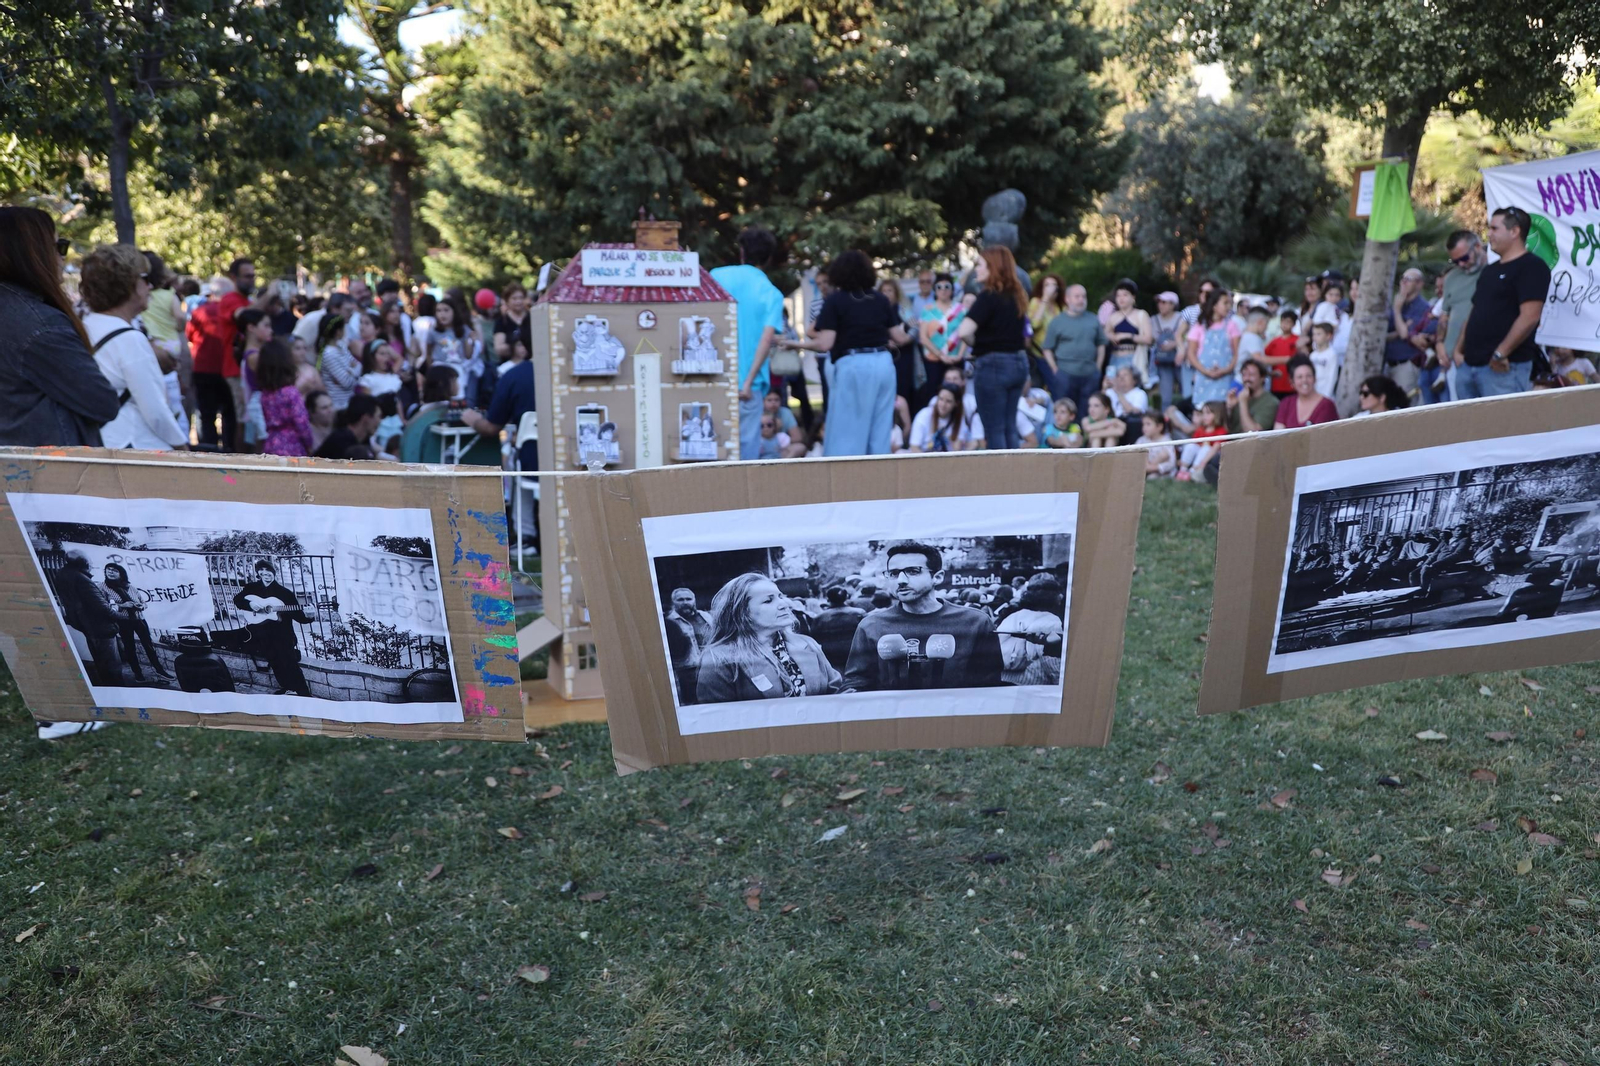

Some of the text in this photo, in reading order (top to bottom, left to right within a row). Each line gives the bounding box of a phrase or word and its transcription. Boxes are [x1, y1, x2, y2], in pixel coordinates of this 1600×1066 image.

[1570, 223, 1600, 266] PA
[680, 267, 693, 277] NO
[106, 554, 188, 573] PARQUE
[951, 573, 1002, 586] Entrada
[348, 588, 442, 622] NEGO
